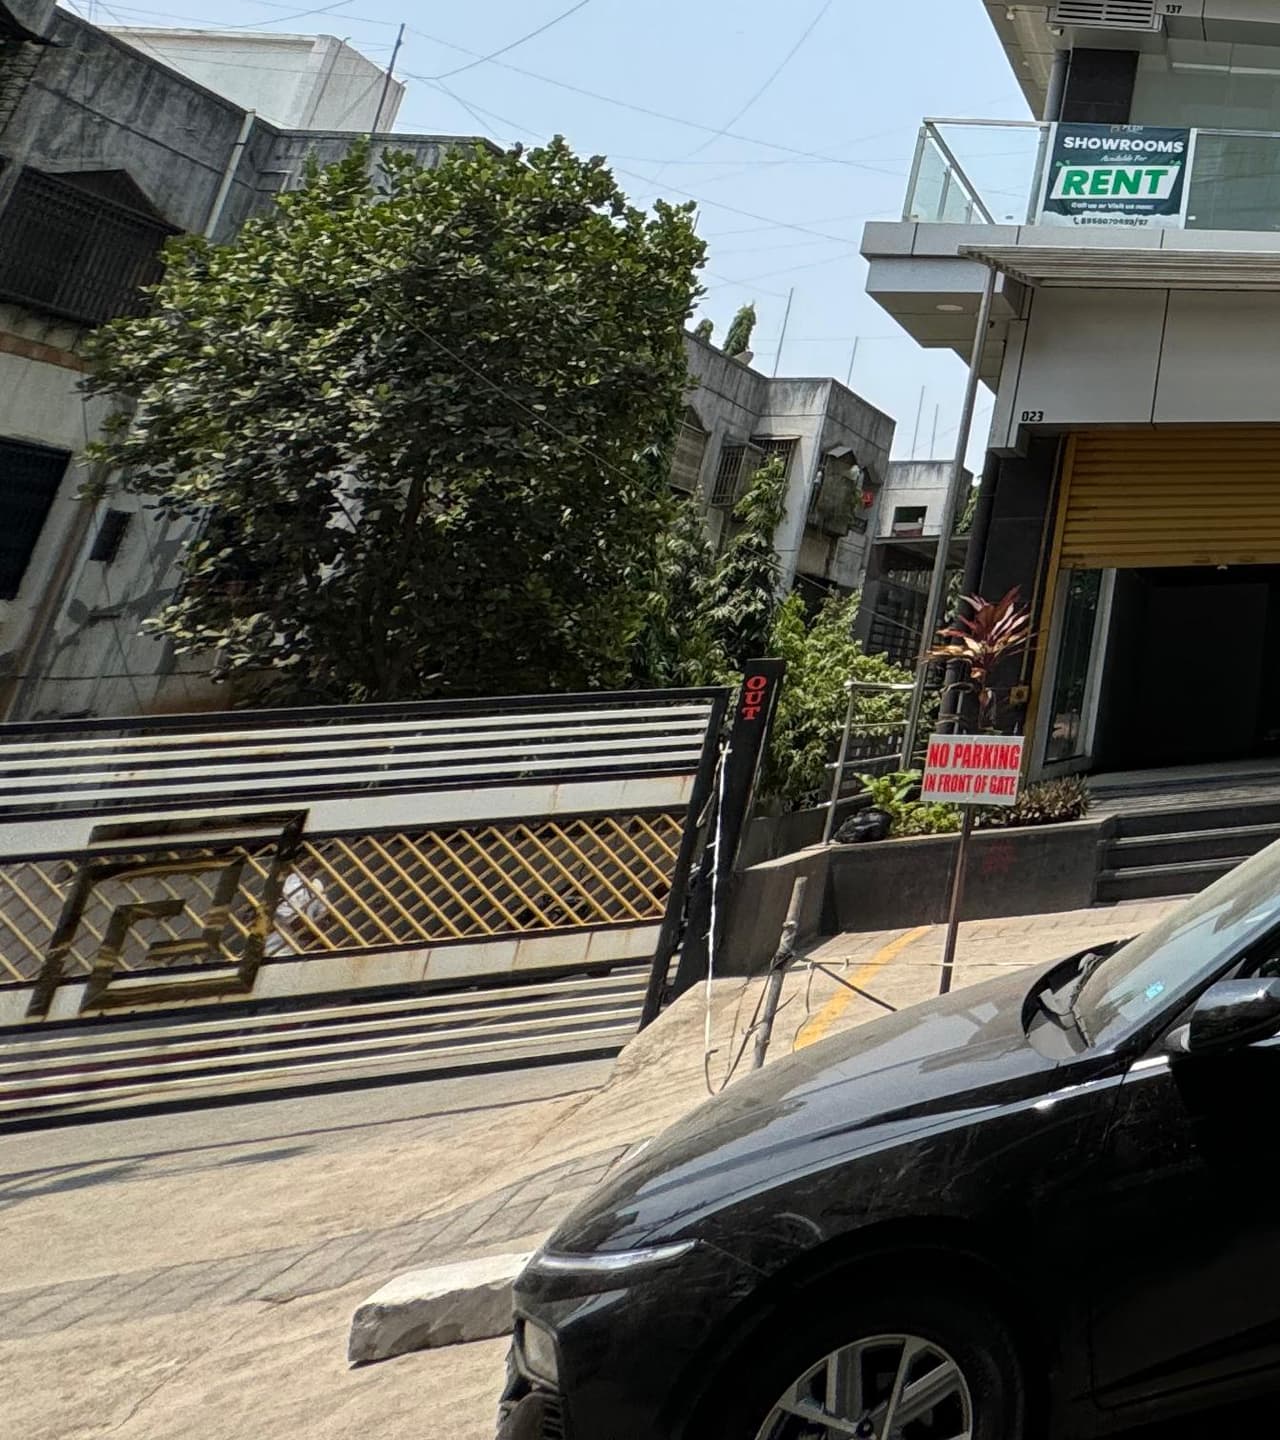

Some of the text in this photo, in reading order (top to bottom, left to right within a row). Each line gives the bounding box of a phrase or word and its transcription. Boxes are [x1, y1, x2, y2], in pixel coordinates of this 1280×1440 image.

[1166, 4, 1182, 14] 137
[1064, 137, 1184, 153] SHOWROOMS
[1061, 169, 1169, 195] RENT
[1022, 410, 1044, 422] 023
[741, 676, 767, 720] OUT
[928, 743, 1021, 770] NO PARKING
[924, 773, 1017, 795] IN FRONT OF GATE
